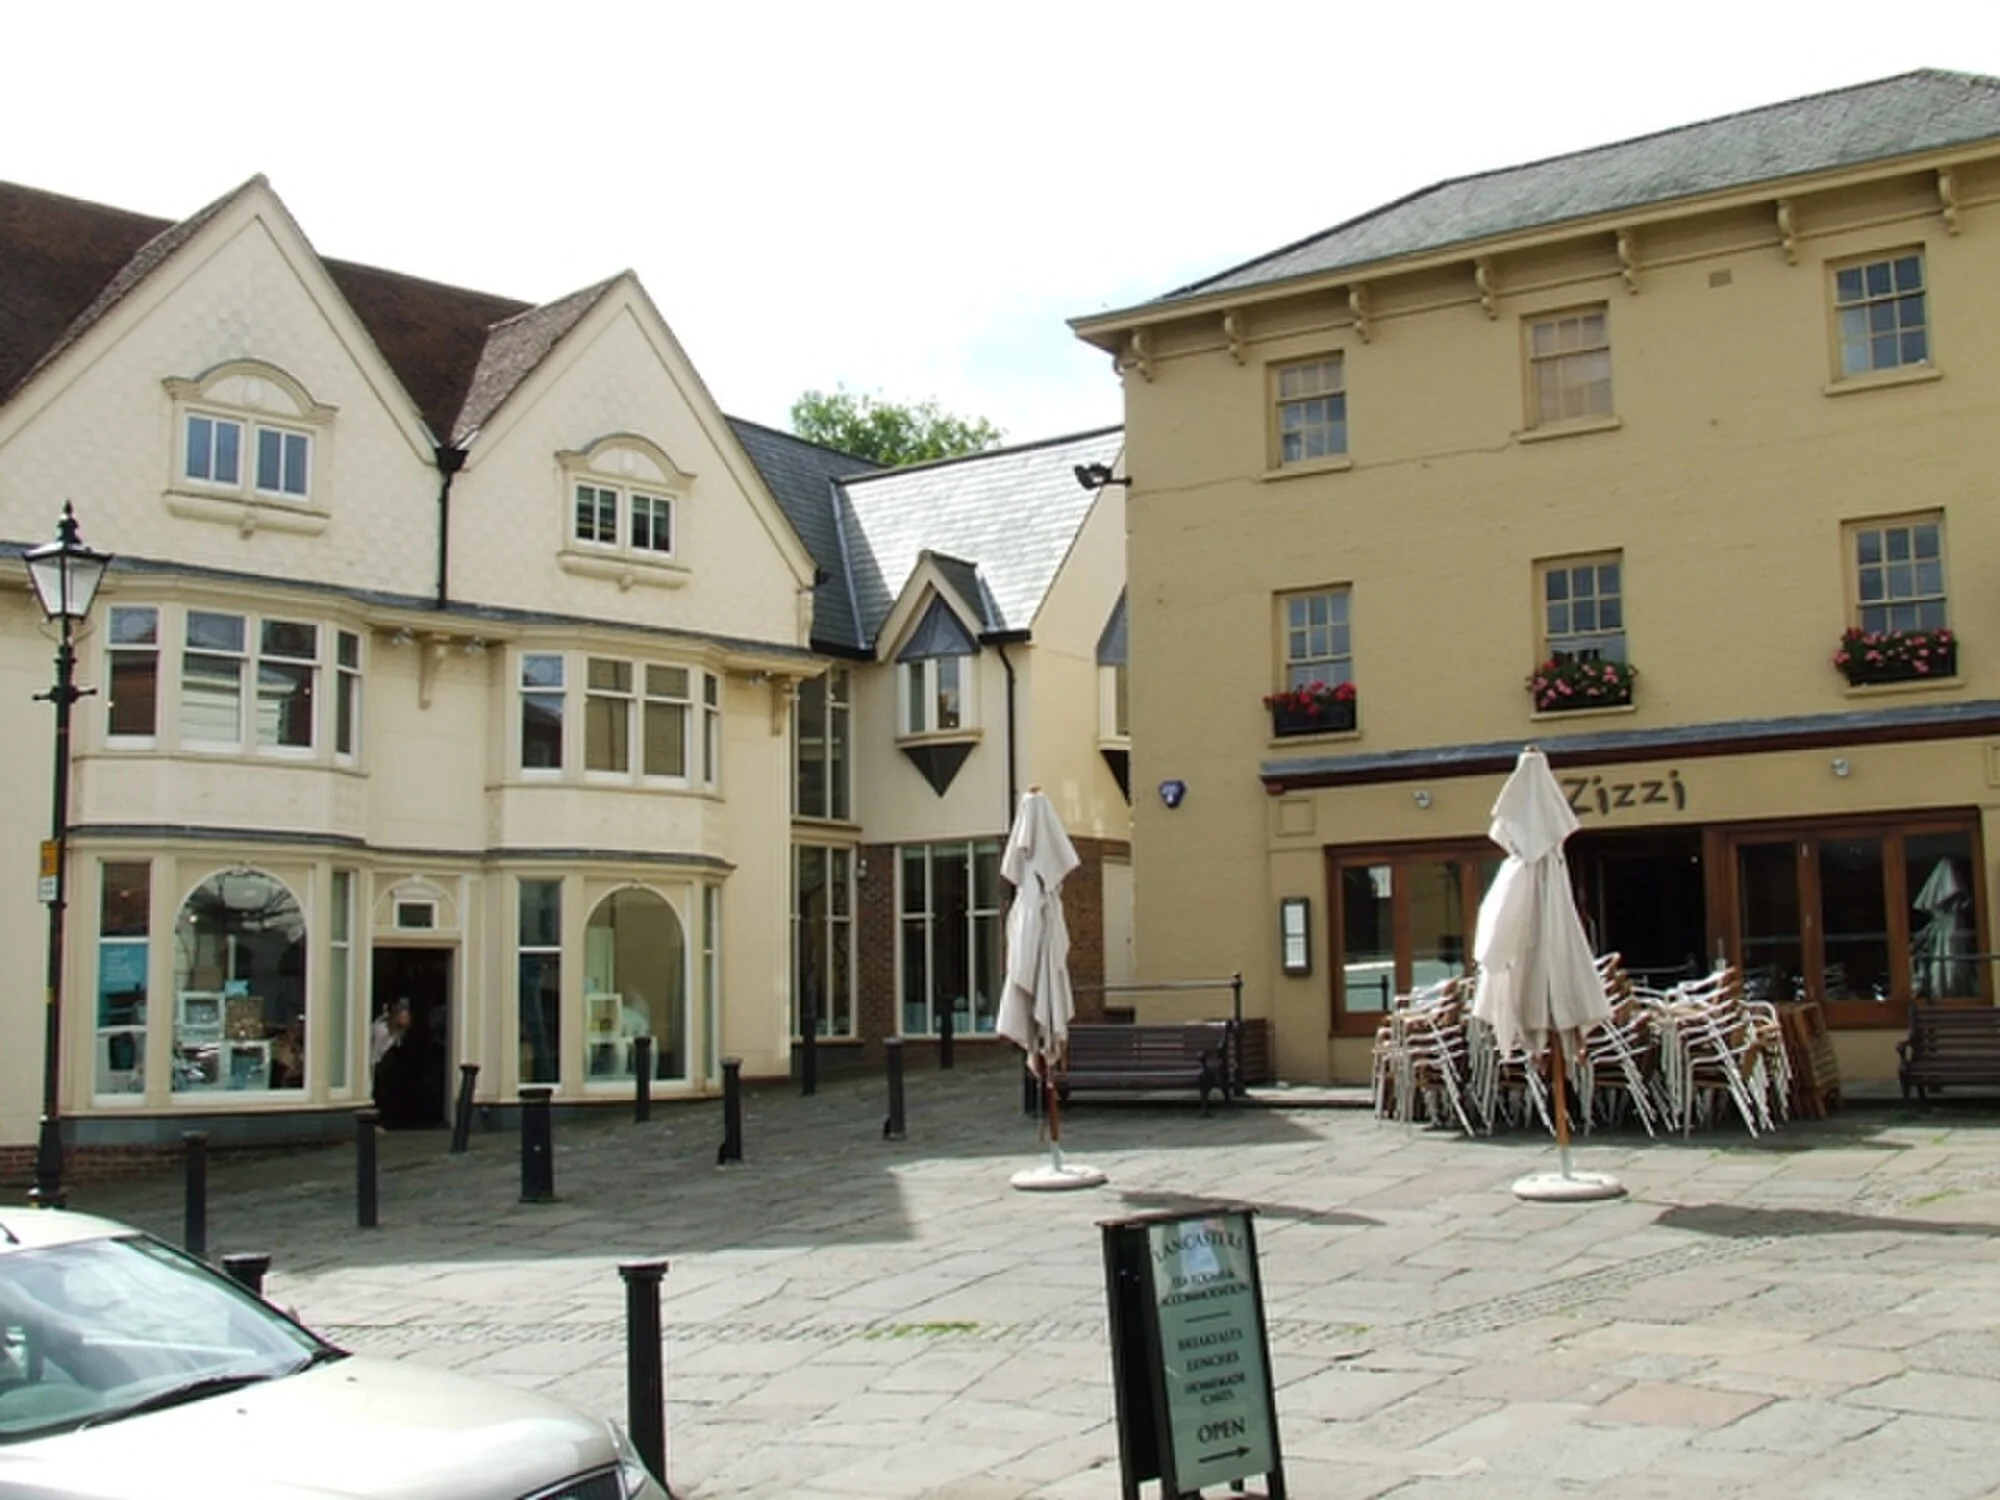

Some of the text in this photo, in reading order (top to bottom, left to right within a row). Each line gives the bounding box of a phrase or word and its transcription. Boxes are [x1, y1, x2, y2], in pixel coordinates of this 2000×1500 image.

[1562, 769, 1686, 816] Zizzi
[1186, 1351, 1241, 1373] LUNCHES
[1185, 1372, 1246, 1396] HOMEMADE
[1200, 1388, 1236, 1406] CAKES
[1197, 1416, 1245, 1445] OPEN
